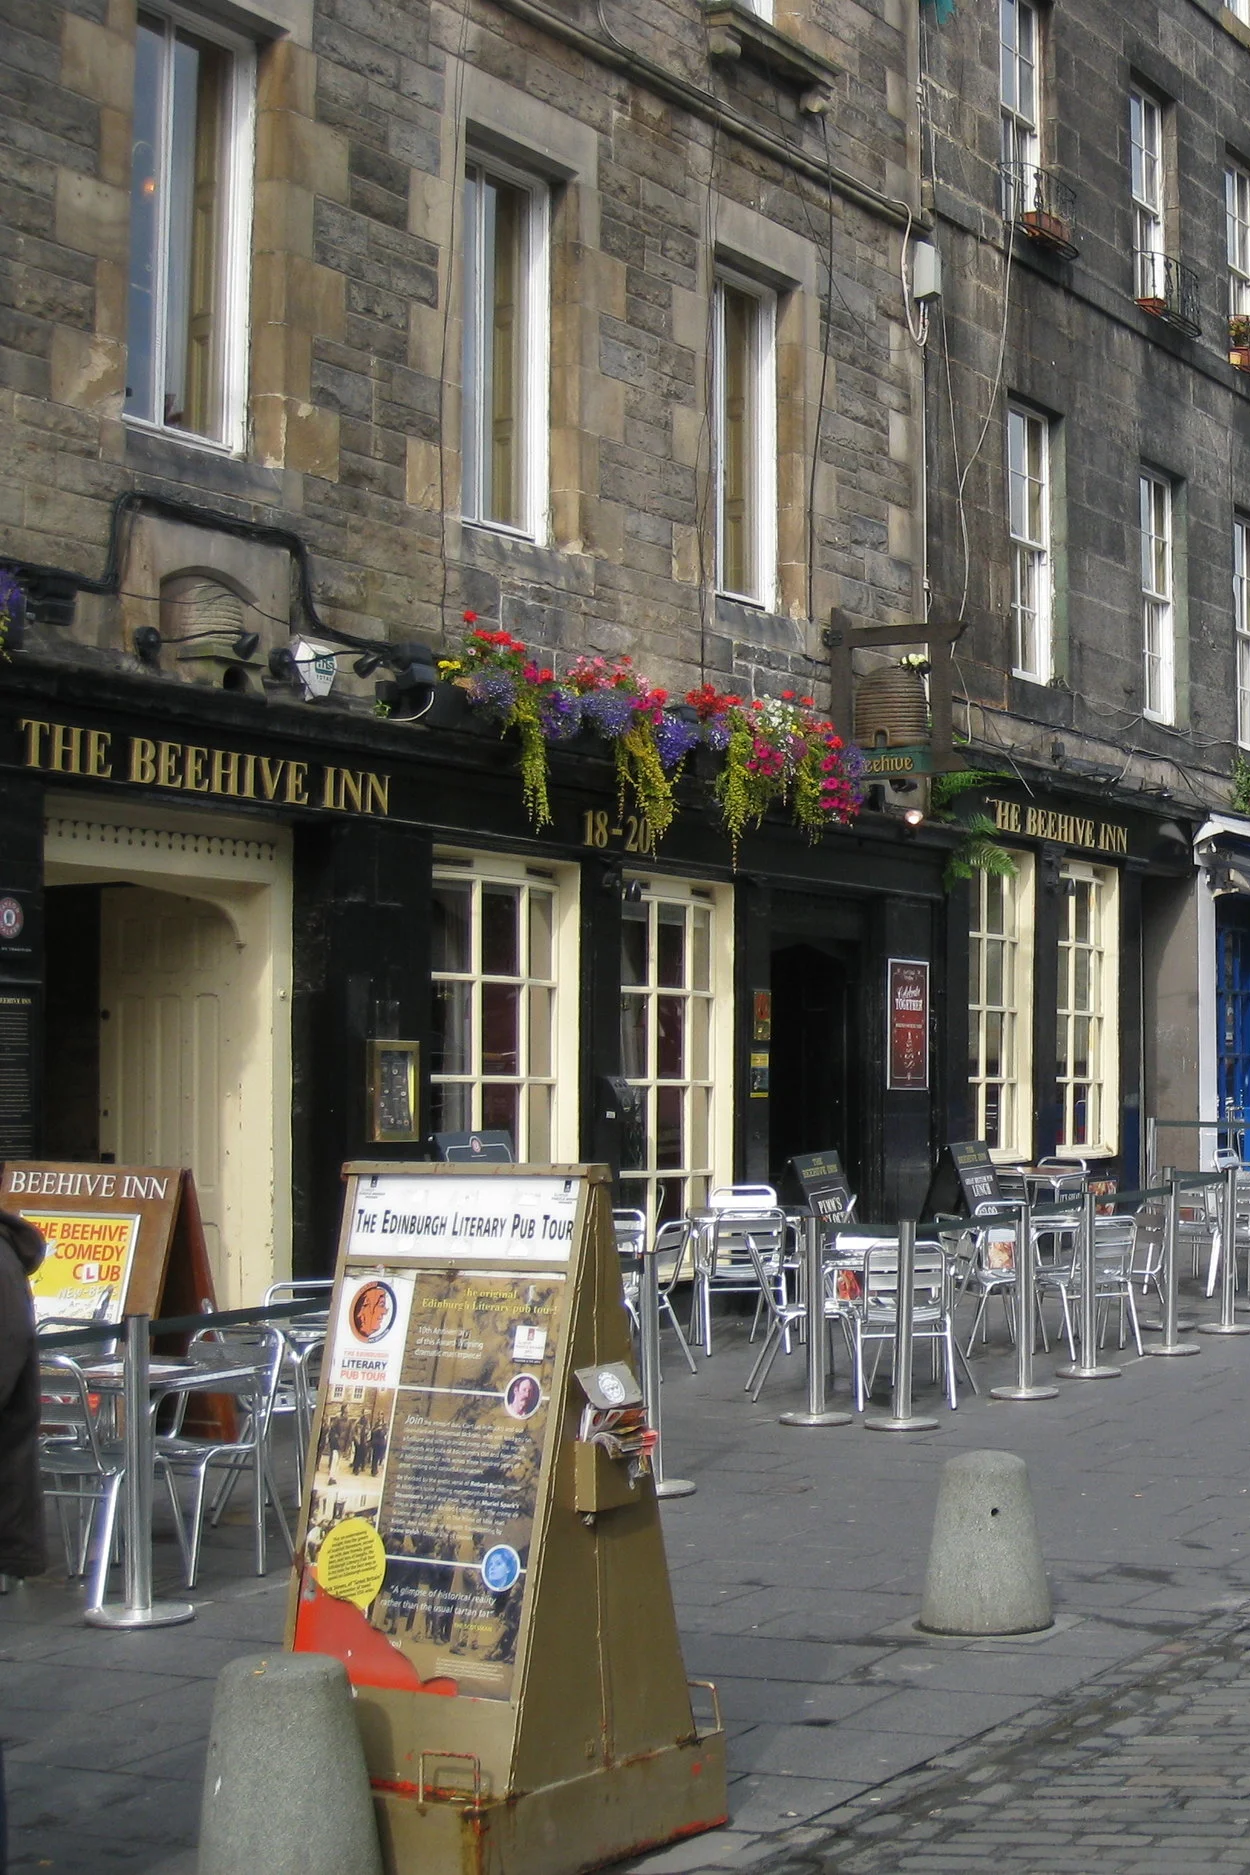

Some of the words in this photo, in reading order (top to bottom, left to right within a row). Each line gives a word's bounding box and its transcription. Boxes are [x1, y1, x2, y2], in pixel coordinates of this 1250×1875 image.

[20, 718, 112, 778] THE
[127, 737, 309, 805] BEEHIVE
[321, 765, 392, 817] INN
[863, 754, 913, 773] eehive
[1025, 807, 1096, 848] BEEHIVE
[1097, 823, 1129, 854] INN
[895, 999, 923, 1011] TOGETHER
[9, 1171, 117, 1198] BEEHIVE
[121, 1175, 169, 1200] INN
[60, 1223, 129, 1242] BEEHIVE
[355, 1209, 377, 1233] THE
[381, 1210, 448, 1236] EDINBURGH
[451, 1211, 508, 1239] LITERARY
[510, 1213, 536, 1239] PUB
[541, 1214, 575, 1241] TOUR
[55, 1242, 126, 1262] COMEDY
[72, 1264, 121, 1282] CLUB
[480, 1289, 518, 1301] original
[422, 1298, 470, 1311] Edinburgh
[472, 1301, 509, 1313] Literary
[512, 1303, 531, 1314] pub
[341, 1359, 388, 1371] LITERARY
[340, 1369, 359, 1380] PUB
[361, 1371, 386, 1382] TOUR
[404, 1414, 424, 1425] Join
[400, 1586, 427, 1597] glimpse
[428, 1589, 437, 1598] of
[437, 1590, 471, 1602] historical
[471, 1592, 497, 1606] reality
[380, 1598, 400, 1607] rather
[402, 1600, 419, 1609] than
[420, 1602, 432, 1611] the
[433, 1604, 454, 1613] usual
[454, 1607, 478, 1616] tartan
